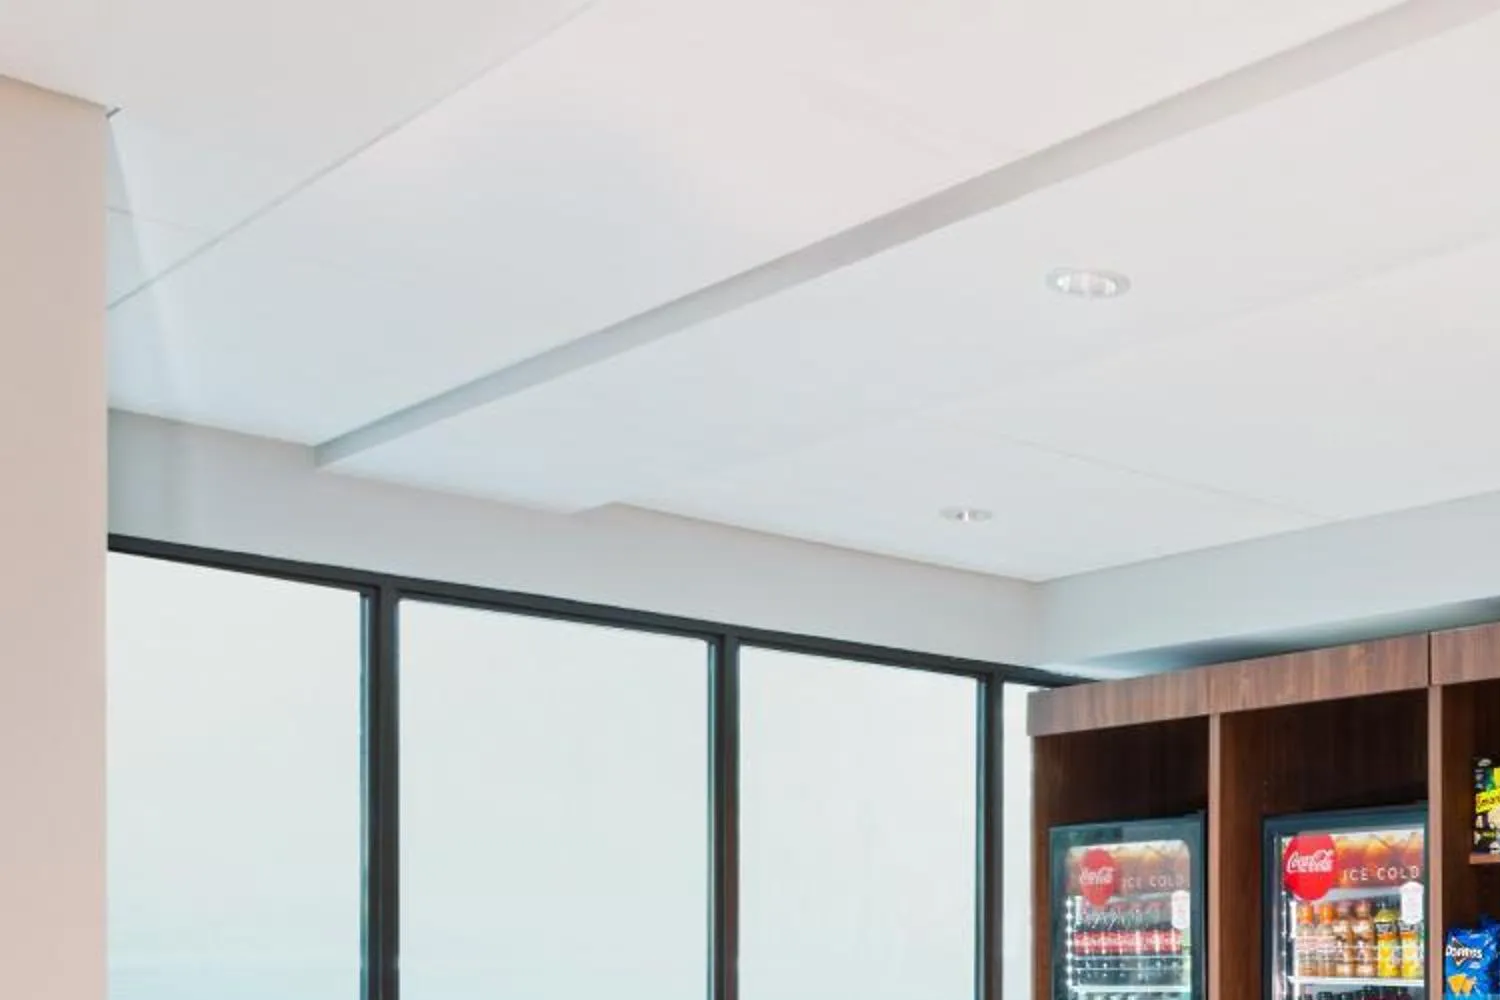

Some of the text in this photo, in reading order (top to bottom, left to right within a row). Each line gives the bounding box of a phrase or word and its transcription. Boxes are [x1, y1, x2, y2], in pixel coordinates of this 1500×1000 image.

[1286, 849, 1334, 873] Coca-Cola
[1343, 866, 1420, 881] ICE COLD
[1121, 875, 1185, 888] ICE COLD
